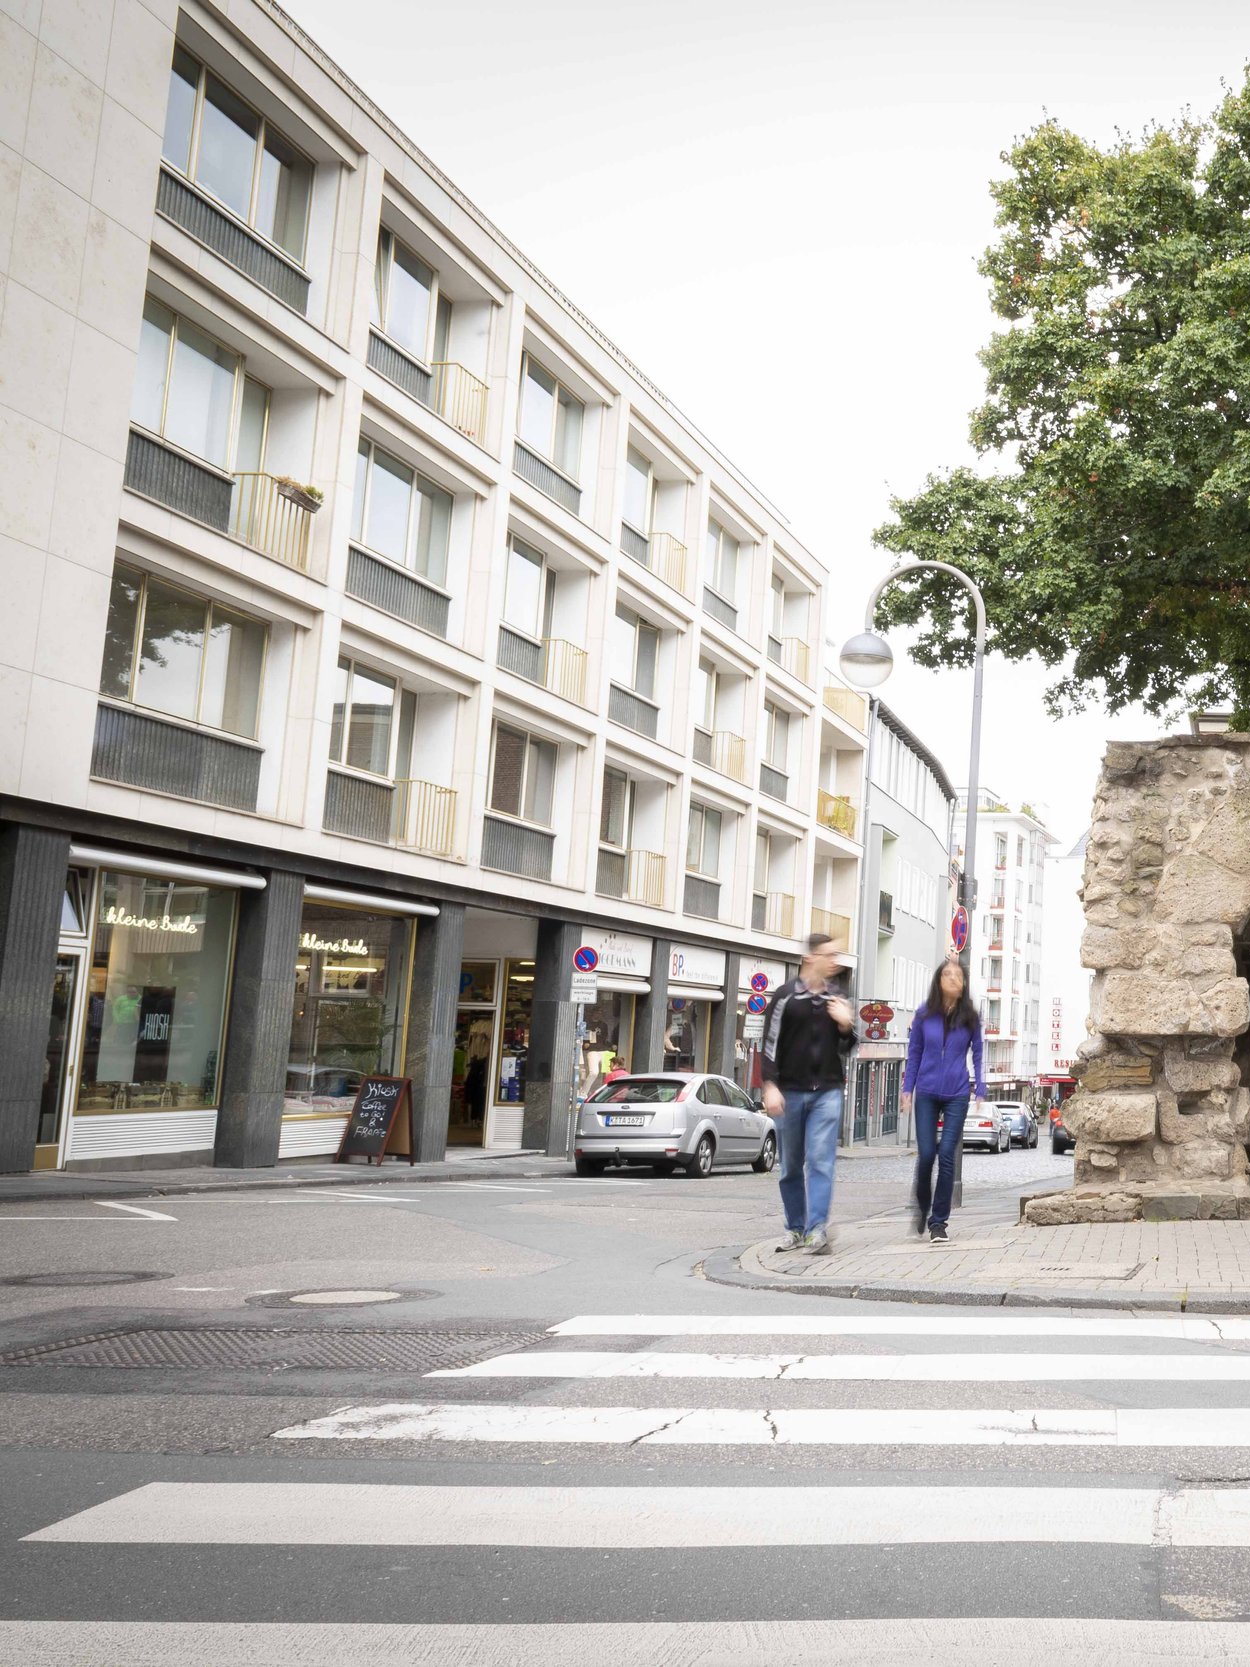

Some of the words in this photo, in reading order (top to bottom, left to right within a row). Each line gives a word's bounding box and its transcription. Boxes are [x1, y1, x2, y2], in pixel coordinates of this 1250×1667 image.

[106, 906, 158, 930] kleine
[160, 914, 198, 934] Bude
[143, 1013, 170, 1041] KIOSK
